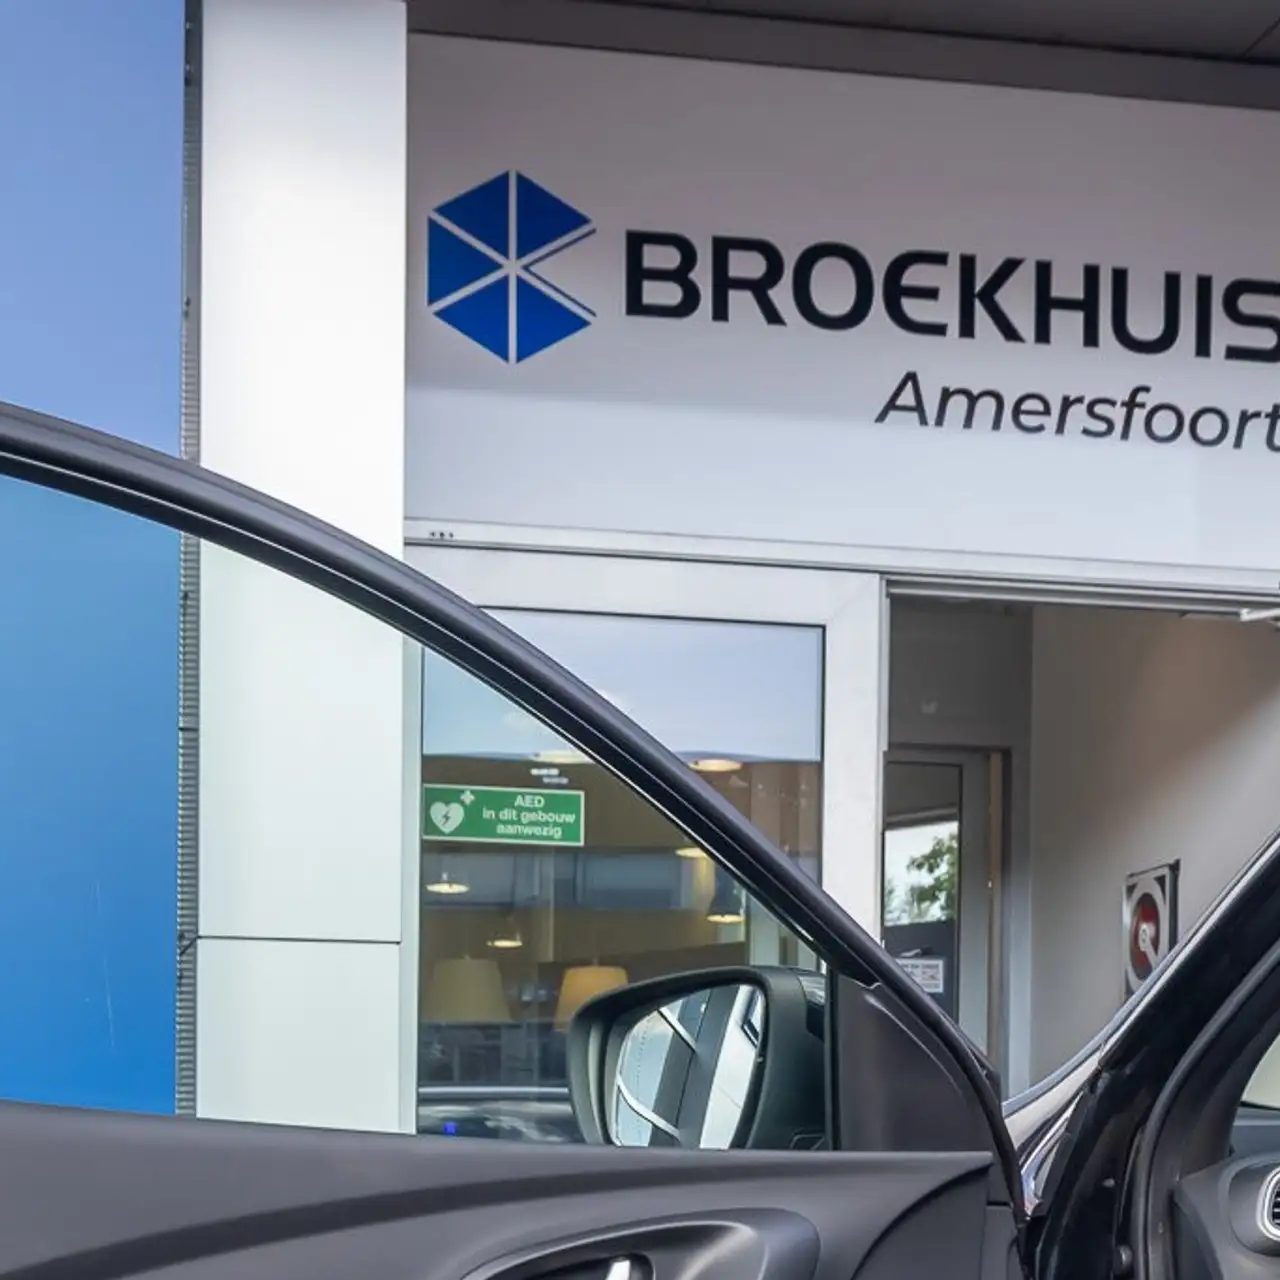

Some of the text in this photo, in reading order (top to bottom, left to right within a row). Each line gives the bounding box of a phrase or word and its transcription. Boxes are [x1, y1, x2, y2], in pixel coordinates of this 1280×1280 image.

[514, 795, 545, 808] AED
[499, 808, 517, 821] dit
[521, 810, 575, 824] gebouw
[496, 824, 562, 839] aanwezig
